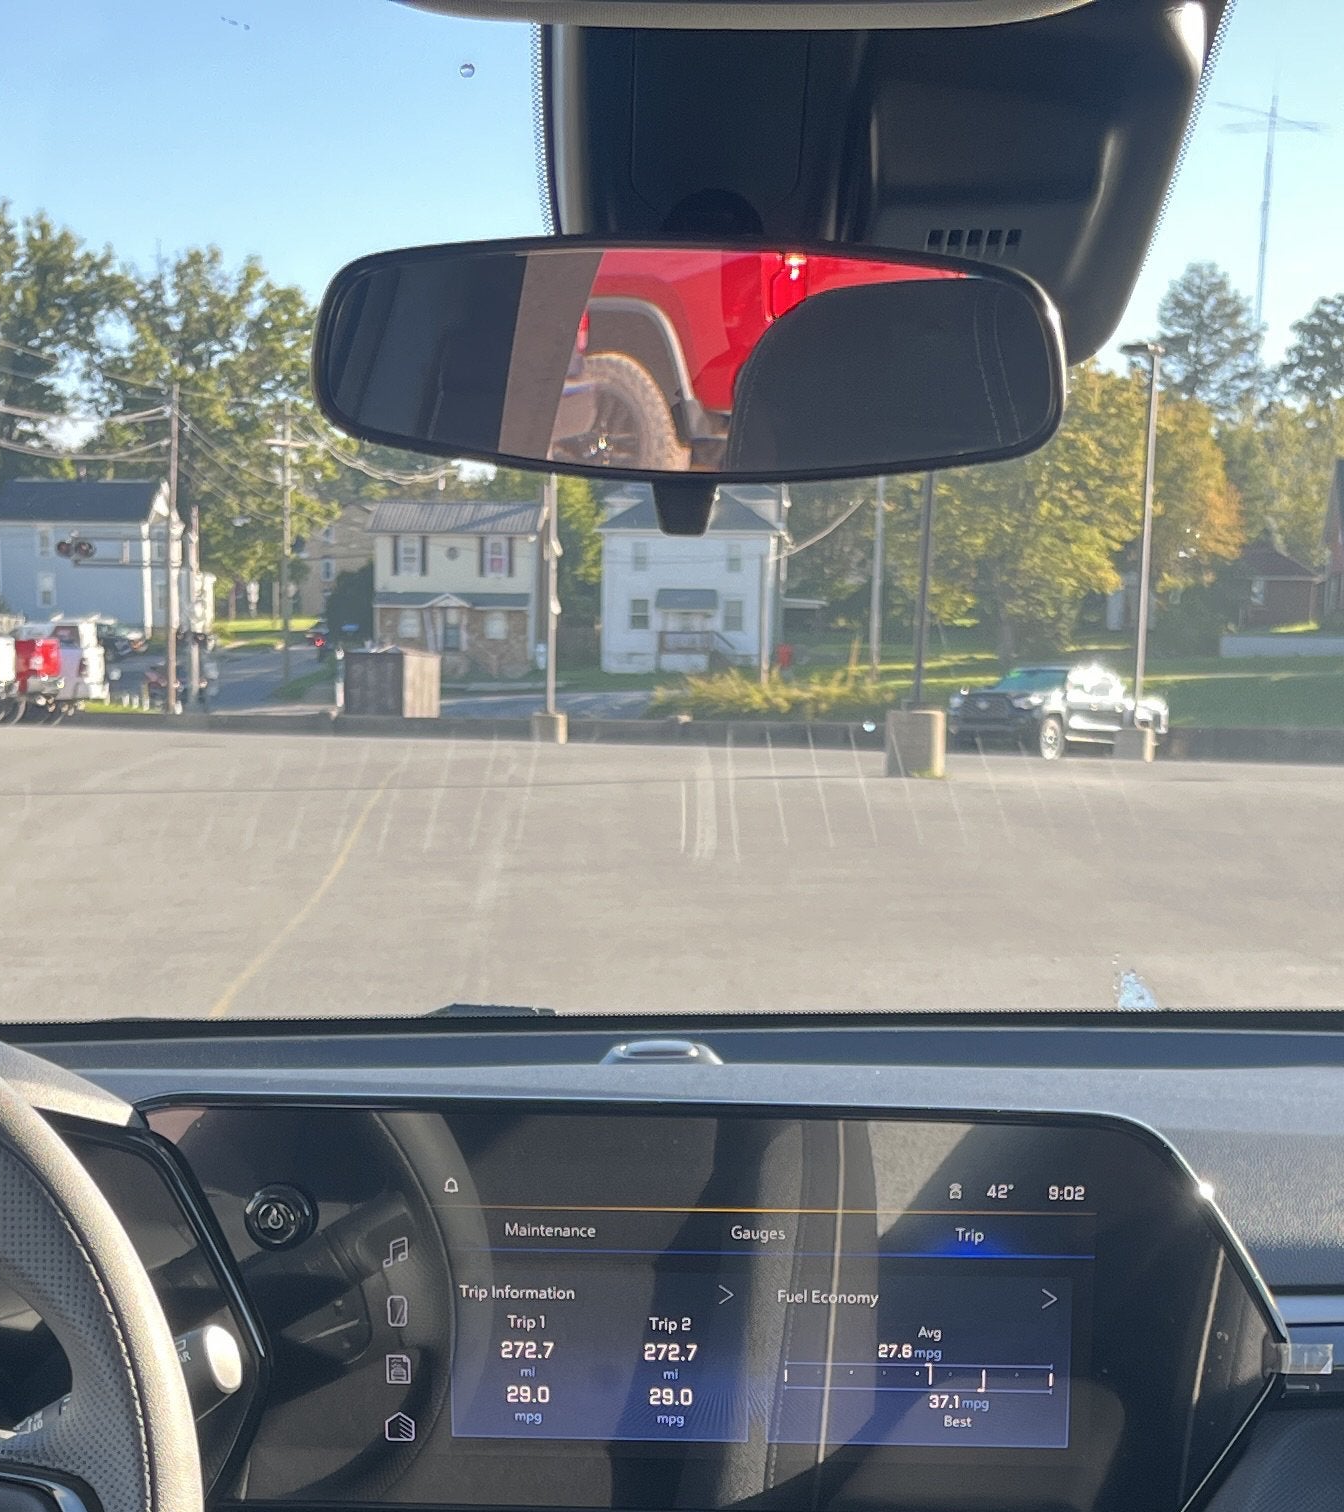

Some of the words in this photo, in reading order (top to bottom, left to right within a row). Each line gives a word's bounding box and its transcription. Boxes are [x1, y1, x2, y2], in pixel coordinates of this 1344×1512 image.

[1048, 1185, 1086, 1201] 9:02
[504, 1221, 597, 1238] Maintenance
[730, 1225, 786, 1243] Gauges
[955, 1226, 985, 1246] Trip
[458, 1284, 487, 1302] Trip
[491, 1284, 576, 1301] Information
[776, 1288, 808, 1306] Fuel
[812, 1289, 879, 1309] Economy
[506, 1314, 536, 1332] Trip
[538, 1315, 546, 1330] 1
[648, 1317, 677, 1334] Trip
[681, 1317, 692, 1331] 2
[917, 1326, 942, 1341] Avg
[500, 1341, 555, 1359] 272.7
[643, 1343, 698, 1361] 272.7
[877, 1343, 913, 1359] 27.6
[914, 1348, 942, 1361] mpg
[520, 1367, 536, 1378] mi
[663, 1369, 679, 1380] mi
[506, 1385, 550, 1403] 29.0
[648, 1388, 693, 1406] 29.0
[928, 1394, 960, 1409] 37.1
[961, 1399, 989, 1412] mpg
[514, 1412, 543, 1425] mpg
[656, 1414, 685, 1427] mpg
[943, 1414, 973, 1428] Best
